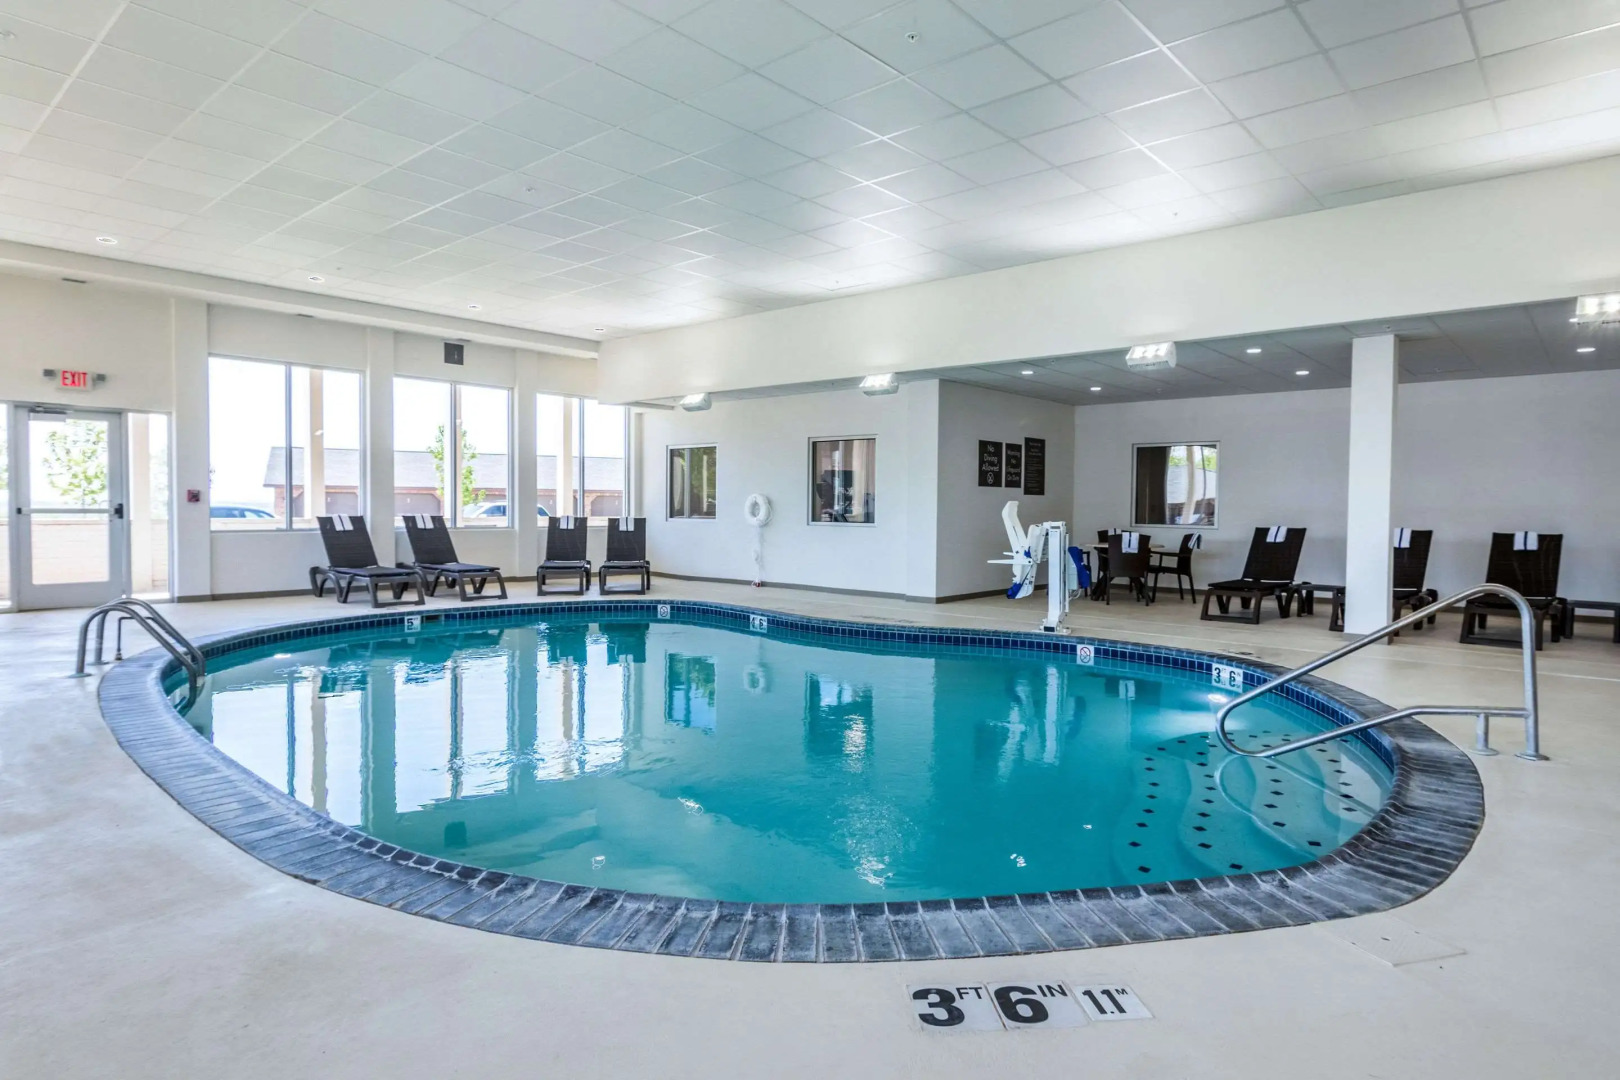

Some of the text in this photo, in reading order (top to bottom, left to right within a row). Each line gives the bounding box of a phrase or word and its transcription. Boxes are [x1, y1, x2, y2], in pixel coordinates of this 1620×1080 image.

[62, 370, 87, 387] EXIT
[988, 444, 994, 452] No
[984, 454, 998, 464] Diving
[982, 463, 999, 471] Allowed
[912, 988, 965, 1027] 3
[955, 986, 983, 1000] FT
[993, 986, 1049, 1024] 6
[1036, 984, 1069, 998] IN
